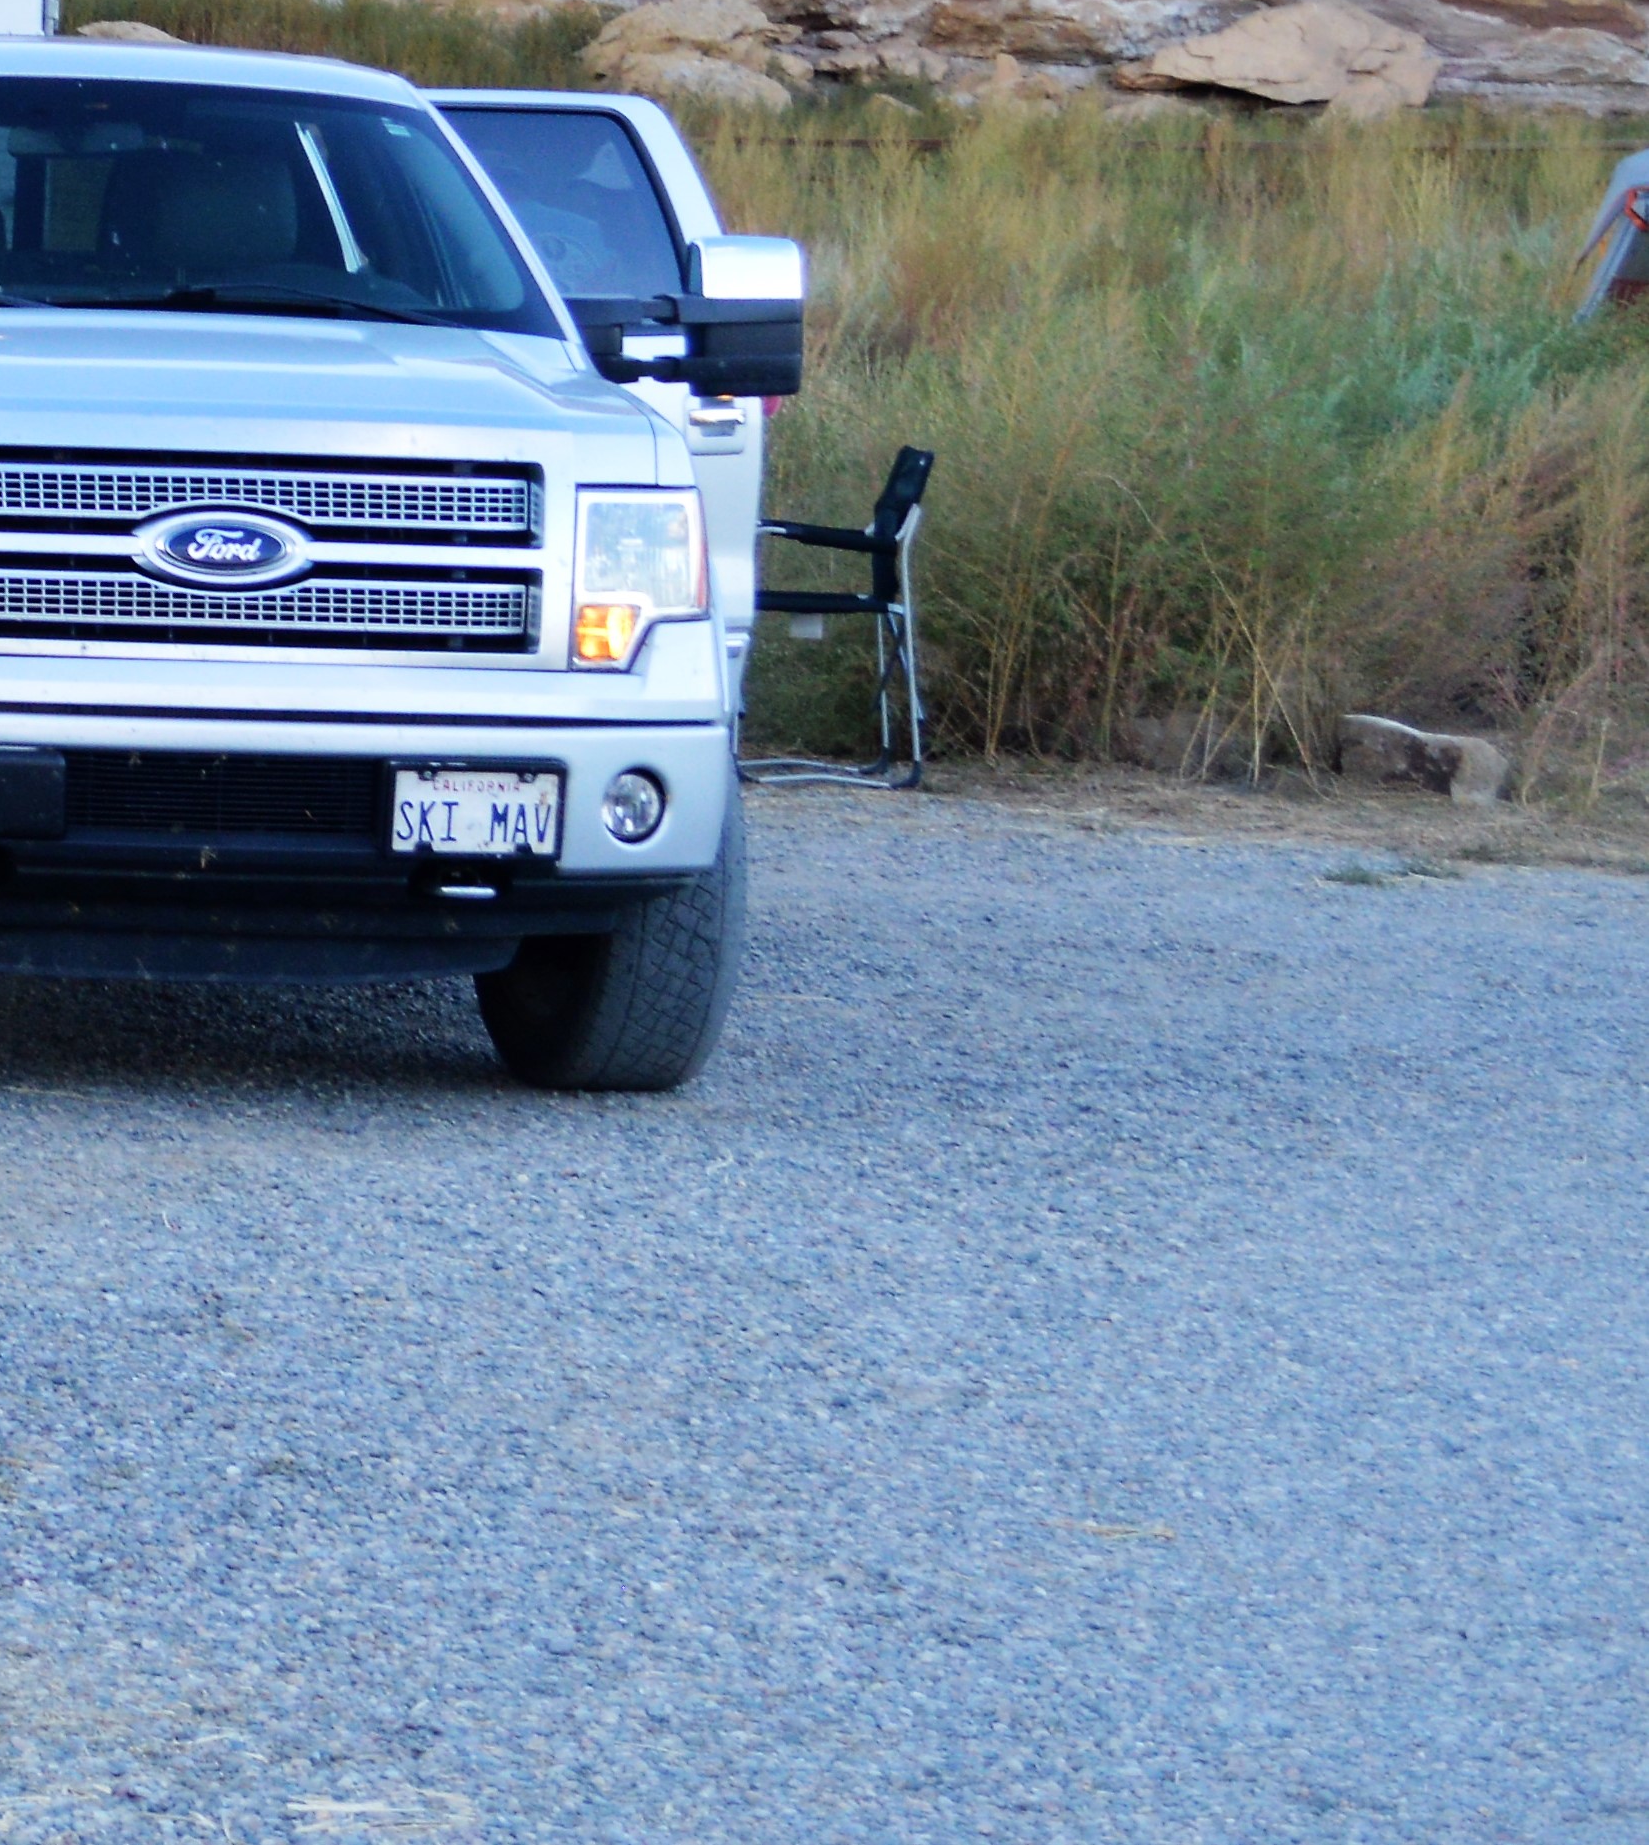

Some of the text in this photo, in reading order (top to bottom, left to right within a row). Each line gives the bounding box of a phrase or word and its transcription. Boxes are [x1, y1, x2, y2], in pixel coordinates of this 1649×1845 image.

[187, 528, 262, 561] Ford
[433, 778, 521, 792] CALIFORNIA
[396, 800, 551, 843] SKI MAV
